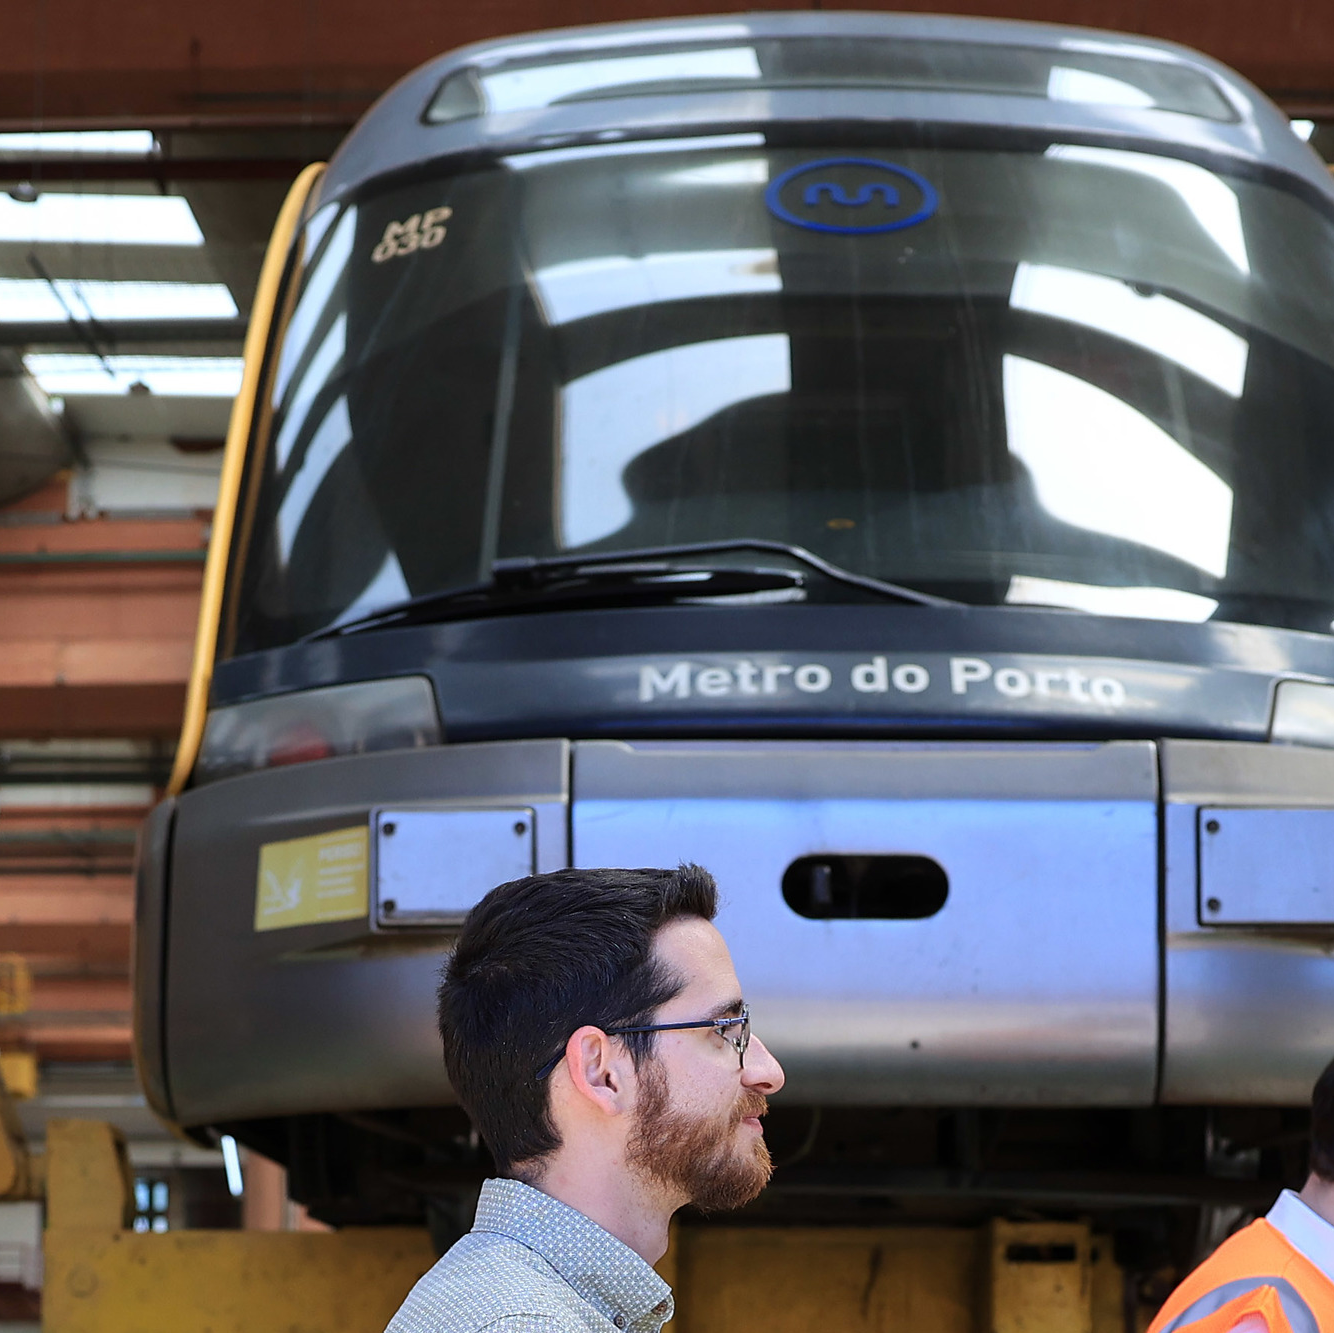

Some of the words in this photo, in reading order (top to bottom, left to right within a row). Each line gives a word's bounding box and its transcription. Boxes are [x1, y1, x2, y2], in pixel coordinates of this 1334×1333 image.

[382, 206, 454, 242] MP
[370, 226, 447, 264] 030
[638, 659, 832, 701] Metro
[850, 656, 930, 694] do
[949, 657, 1126, 707] Porto
